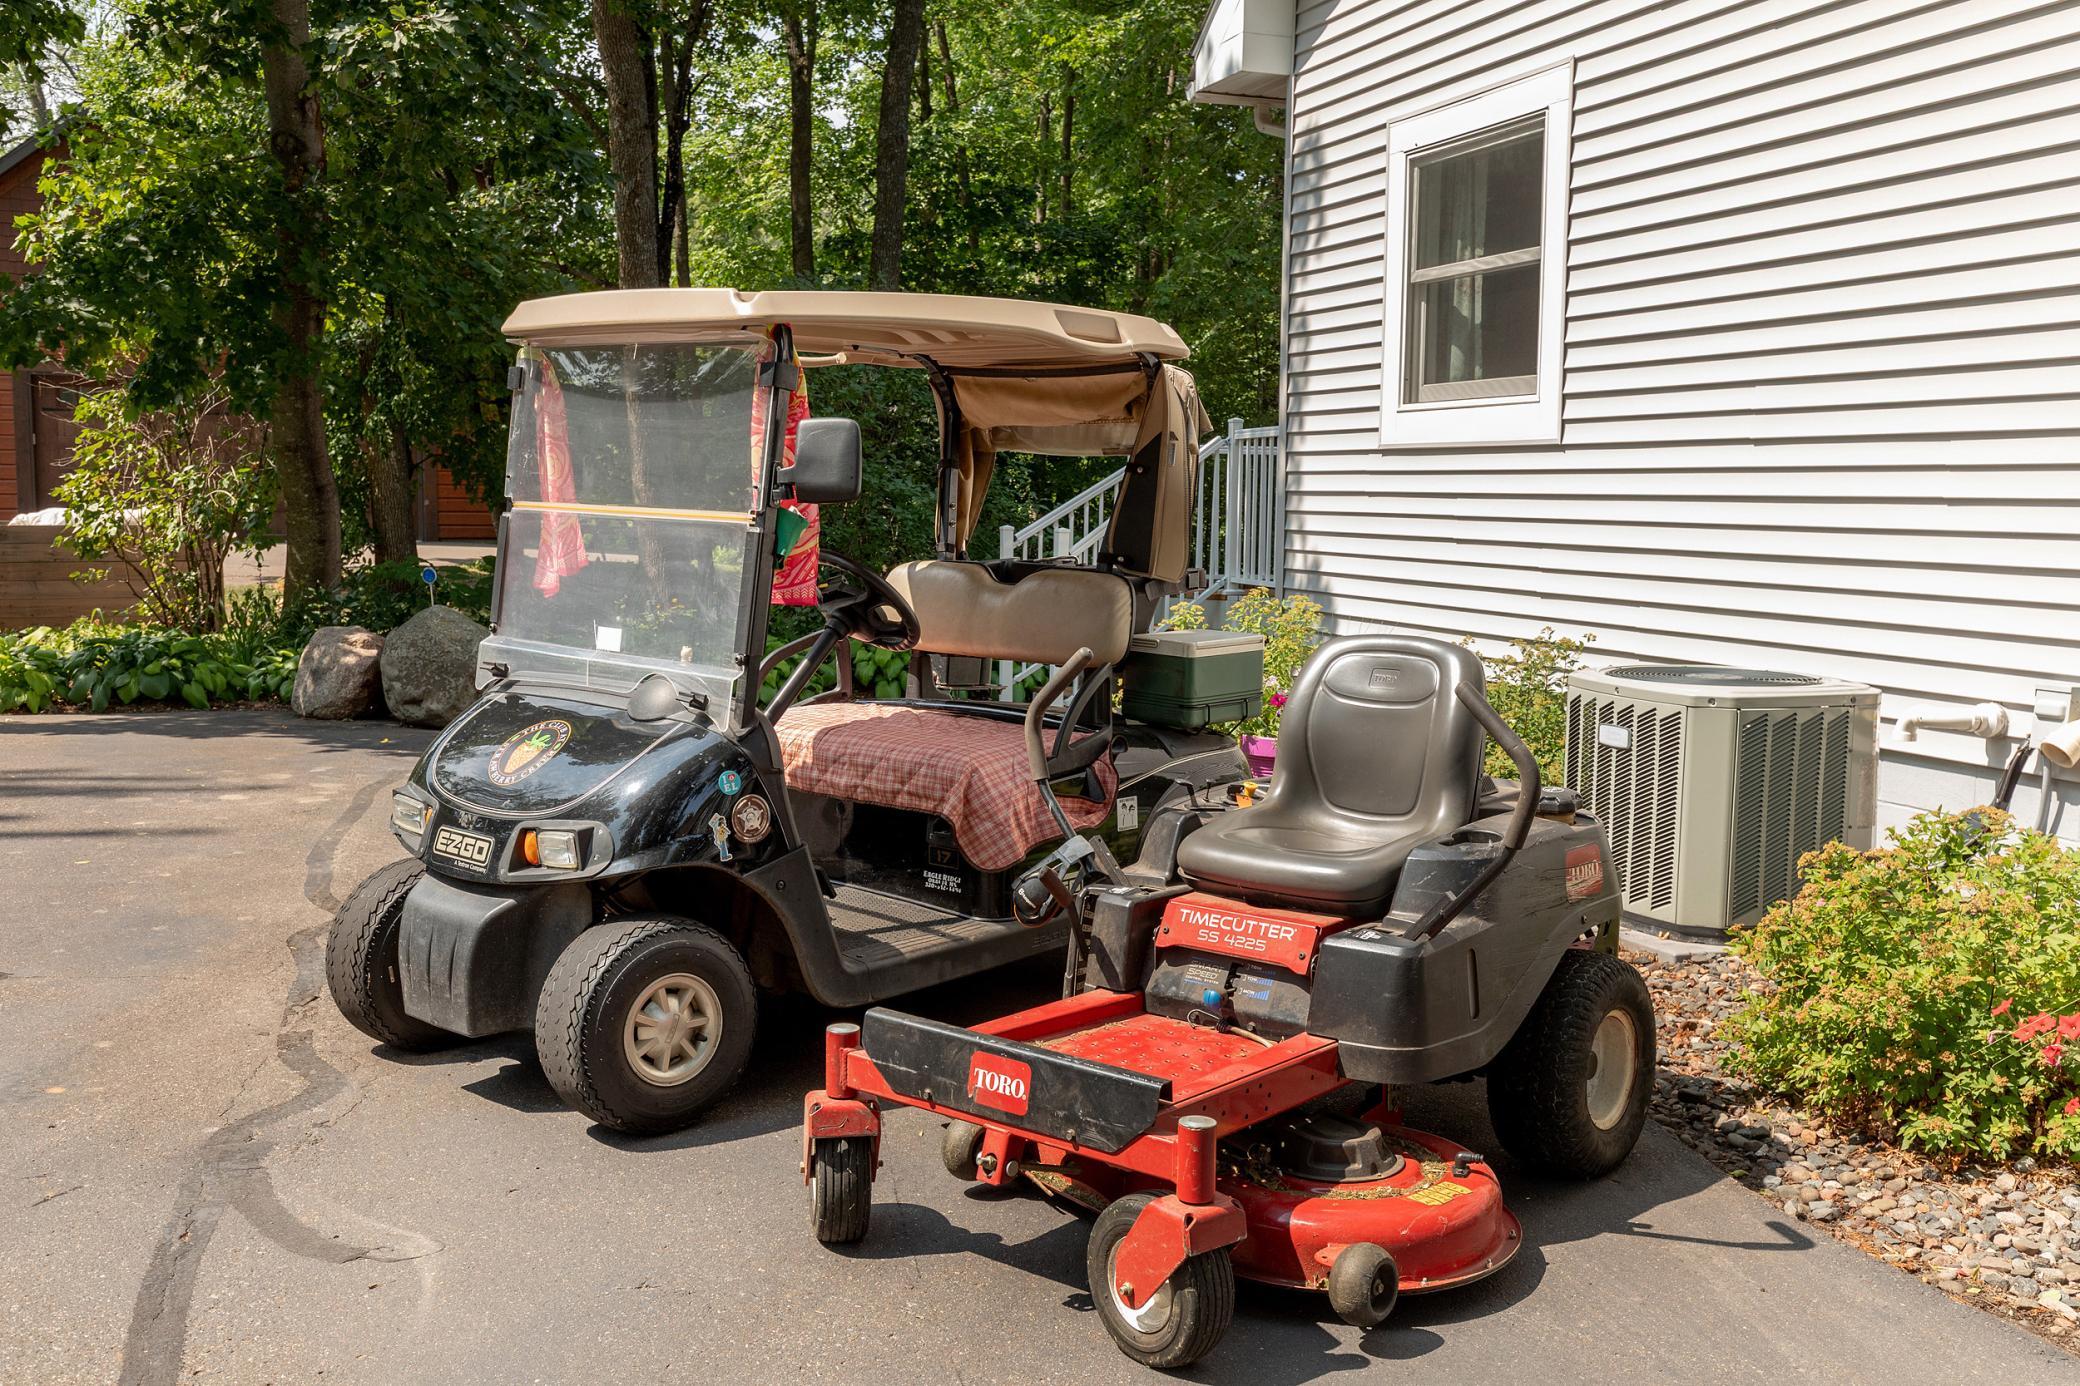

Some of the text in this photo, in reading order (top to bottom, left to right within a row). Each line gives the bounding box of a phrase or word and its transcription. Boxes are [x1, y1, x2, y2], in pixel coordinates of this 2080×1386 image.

[724, 782, 739, 792] EL
[436, 830, 491, 862] EZGO
[937, 850, 952, 863] 17
[1567, 860, 1600, 881] TORO
[1180, 909, 1297, 941] TIMECUTTER
[1197, 929, 1267, 951] SS 4225
[1186, 967, 1218, 979] SPEED
[1189, 960, 1225, 973] SMART
[973, 1067, 1026, 1100] TORO
